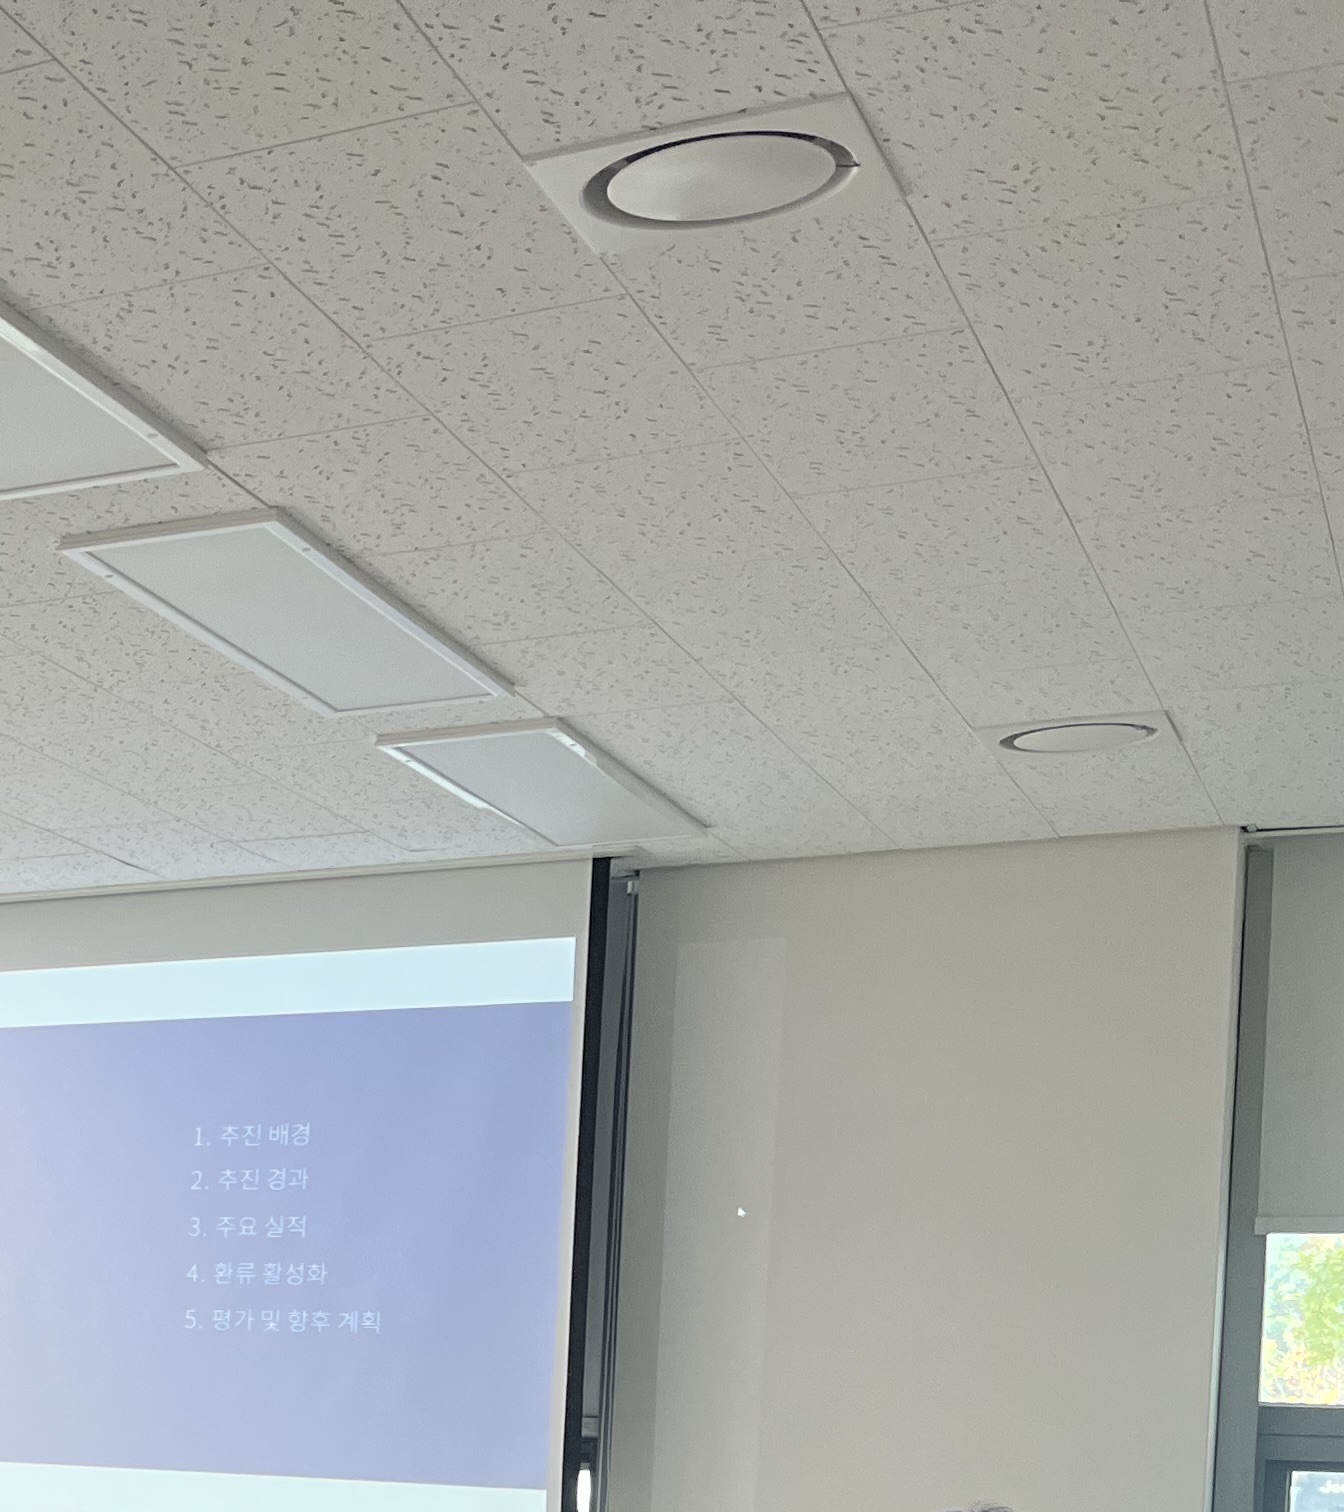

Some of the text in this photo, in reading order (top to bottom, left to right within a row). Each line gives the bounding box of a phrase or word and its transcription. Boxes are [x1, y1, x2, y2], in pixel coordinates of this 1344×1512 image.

[193, 1122, 311, 1147] 1. 추진 배경
[190, 1168, 309, 1191] 2. 추진 경과
[188, 1215, 307, 1238] 3. 주요 실적
[186, 1264, 205, 1283] 4.
[263, 1262, 329, 1285] 활성화
[184, 1308, 382, 1334] 5. 평가 및 향후 계획
